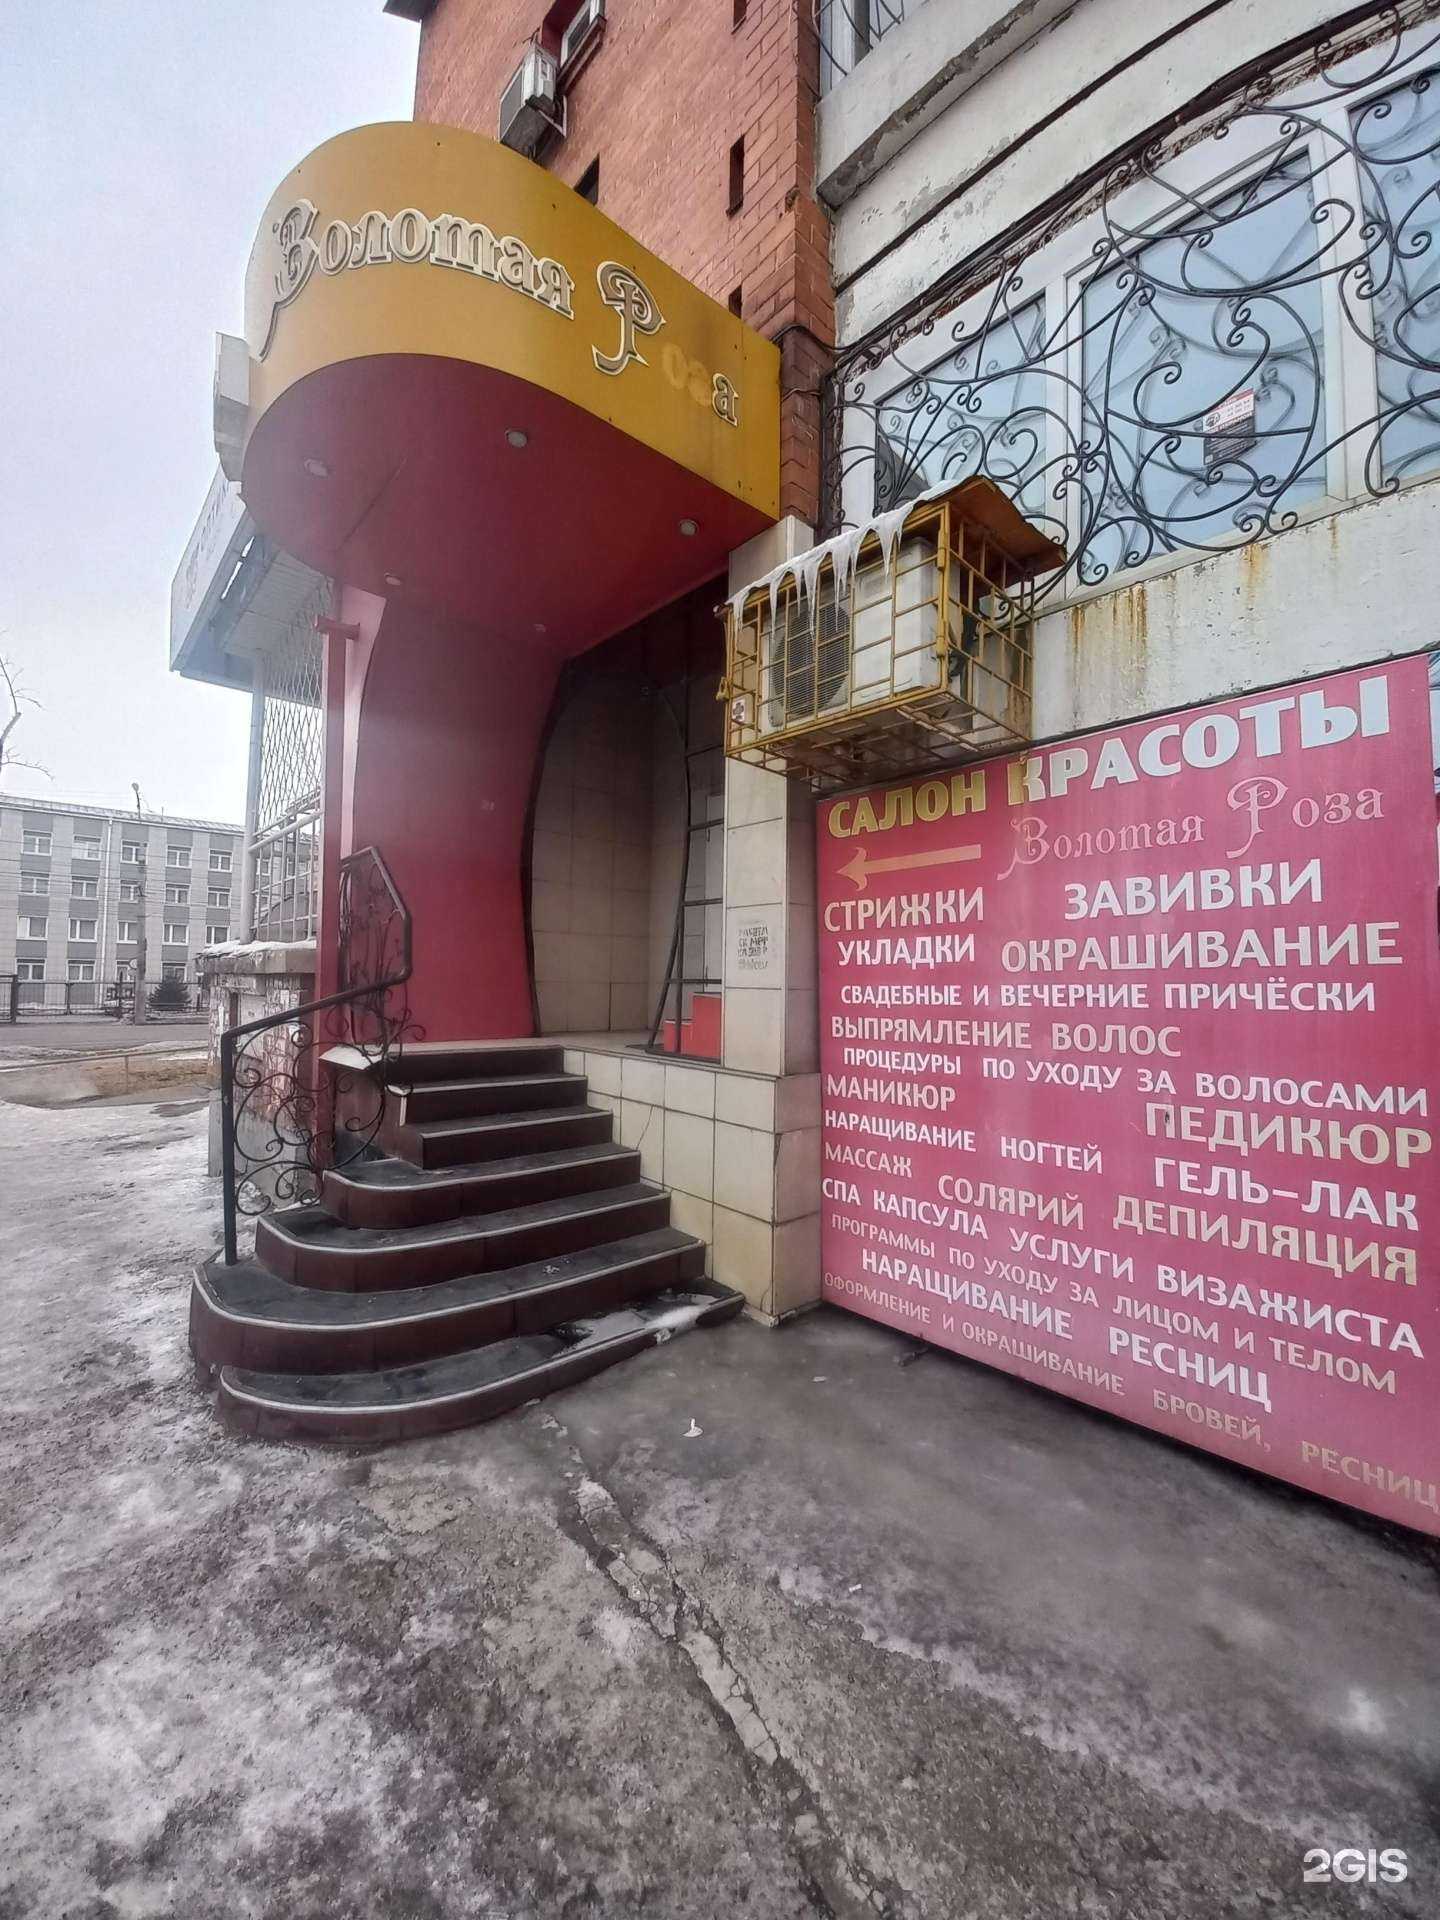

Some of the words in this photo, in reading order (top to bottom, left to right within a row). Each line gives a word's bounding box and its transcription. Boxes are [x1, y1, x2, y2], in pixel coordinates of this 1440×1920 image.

[827, 770, 986, 838] САЛОН
[1008, 675, 1390, 805] КРАСОТЫ
[1226, 776, 1384, 858] Роза
[824, 886, 984, 932] СТРИЖКИ
[1064, 858, 1322, 920] ЗАВИВКИ
[838, 934, 975, 969] УКЛАДКИ
[1001, 922, 1403, 972] ОКРАШИВАНИЕ
[841, 984, 962, 1007] СВАДЕБНЫЕ
[972, 986, 989, 1006] И
[1000, 984, 1149, 1009] ВЕЧЕРНИЕ
[1165, 976, 1375, 1011] ПРИЧЁСКИ
[832, 1016, 1032, 1050] ВЫПРЯМЛЕНИЕ
[1052, 1023, 1182, 1058] ВОЛОС
[827, 1074, 956, 1112] МАНИКЮР
[844, 1048, 962, 1076] ПРОЦЕДУРЫ
[982, 1057, 1016, 1079] ПО
[1026, 1060, 1122, 1093] УХОДУ
[1136, 1068, 1176, 1094] ЗА
[1196, 1073, 1427, 1116] ВОЛОСАМИ
[824, 1110, 976, 1152] НАРАЩИВАНИЕ
[1000, 1138, 1103, 1174] НОГТЕЙ
[824, 1142, 912, 1179] МАССАЖ
[1146, 1102, 1432, 1168] ПЕДИКЮР
[822, 1177, 861, 1206] СПА
[873, 1190, 988, 1240] КАПСУЛА
[938, 1174, 1084, 1230] СОЛЯРИЙ
[1114, 1194, 1418, 1286] ДЕПИЛЯЦИЯ
[831, 1214, 936, 1258] ПРОГРАММЫ
[948, 1246, 976, 1270] ПО
[984, 1255, 1058, 1296] УХОДУ
[1069, 1281, 1100, 1308] ЗА
[1113, 1294, 1218, 1344] ЛИЦОМ
[1234, 1326, 1256, 1354] И
[1270, 1338, 1396, 1395] ТЕЛОМ
[1010, 1227, 1134, 1283] УСЛУГИ
[1156, 1264, 1424, 1358] ВИЗАЖИСТА
[824, 1272, 932, 1325] ОФОРМЛЕНИЕ
[942, 1317, 956, 1334] И
[962, 1320, 1126, 1396] ОКРАШИВАНИЕ
[1152, 1388, 1272, 1452] БРОВЕЙ,
[862, 1250, 1073, 1341] НАРАЩИВАНИЕ
[1109, 1326, 1272, 1413] РЕСНИЦ
